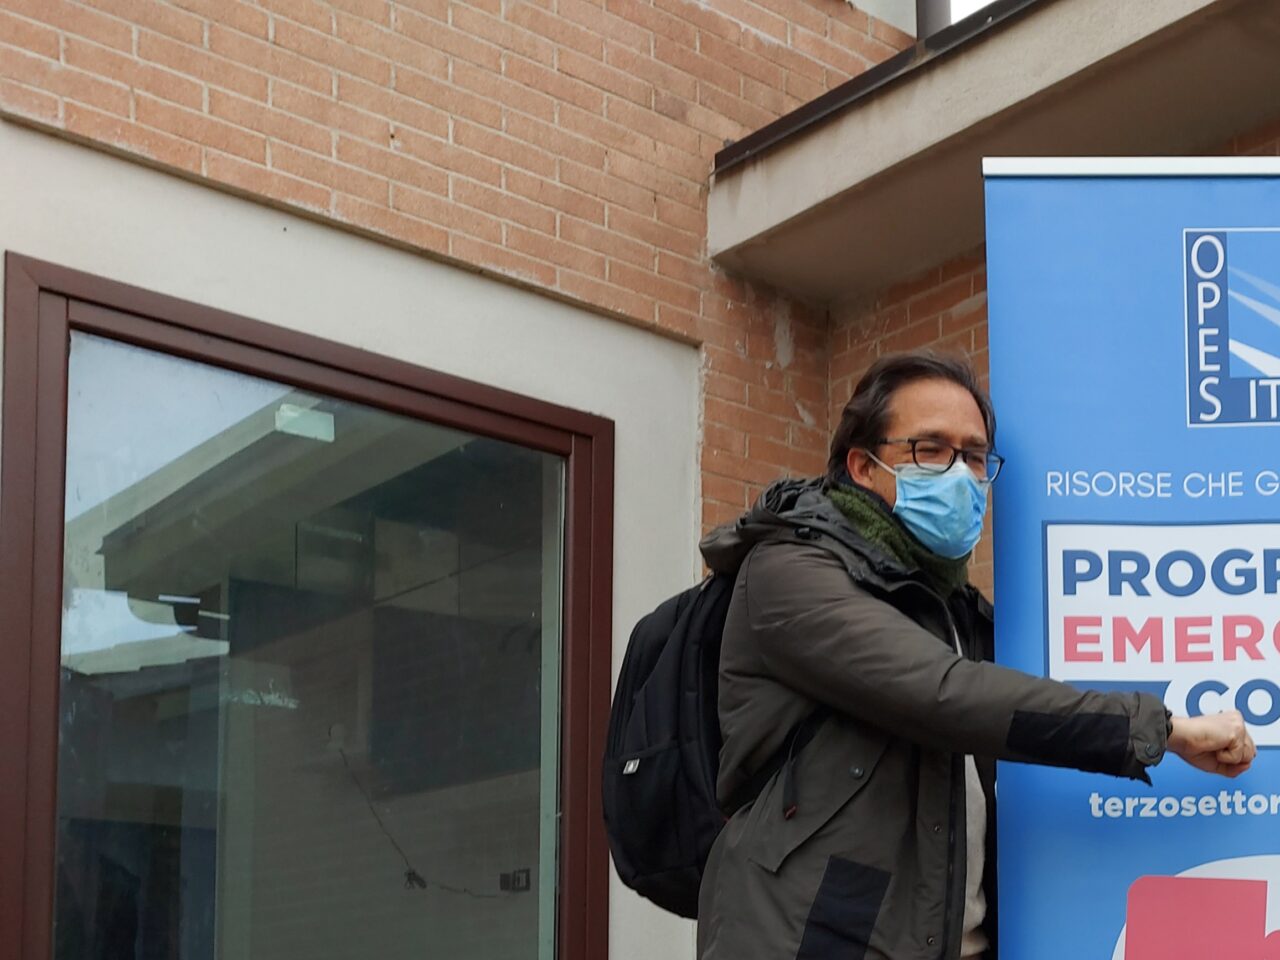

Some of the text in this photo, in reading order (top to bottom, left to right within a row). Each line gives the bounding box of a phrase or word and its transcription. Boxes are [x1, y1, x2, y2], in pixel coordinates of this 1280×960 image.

[1190, 234, 1225, 422] OPES
[1047, 470, 1172, 498] RISORSE
[1182, 470, 1244, 499] CHE
